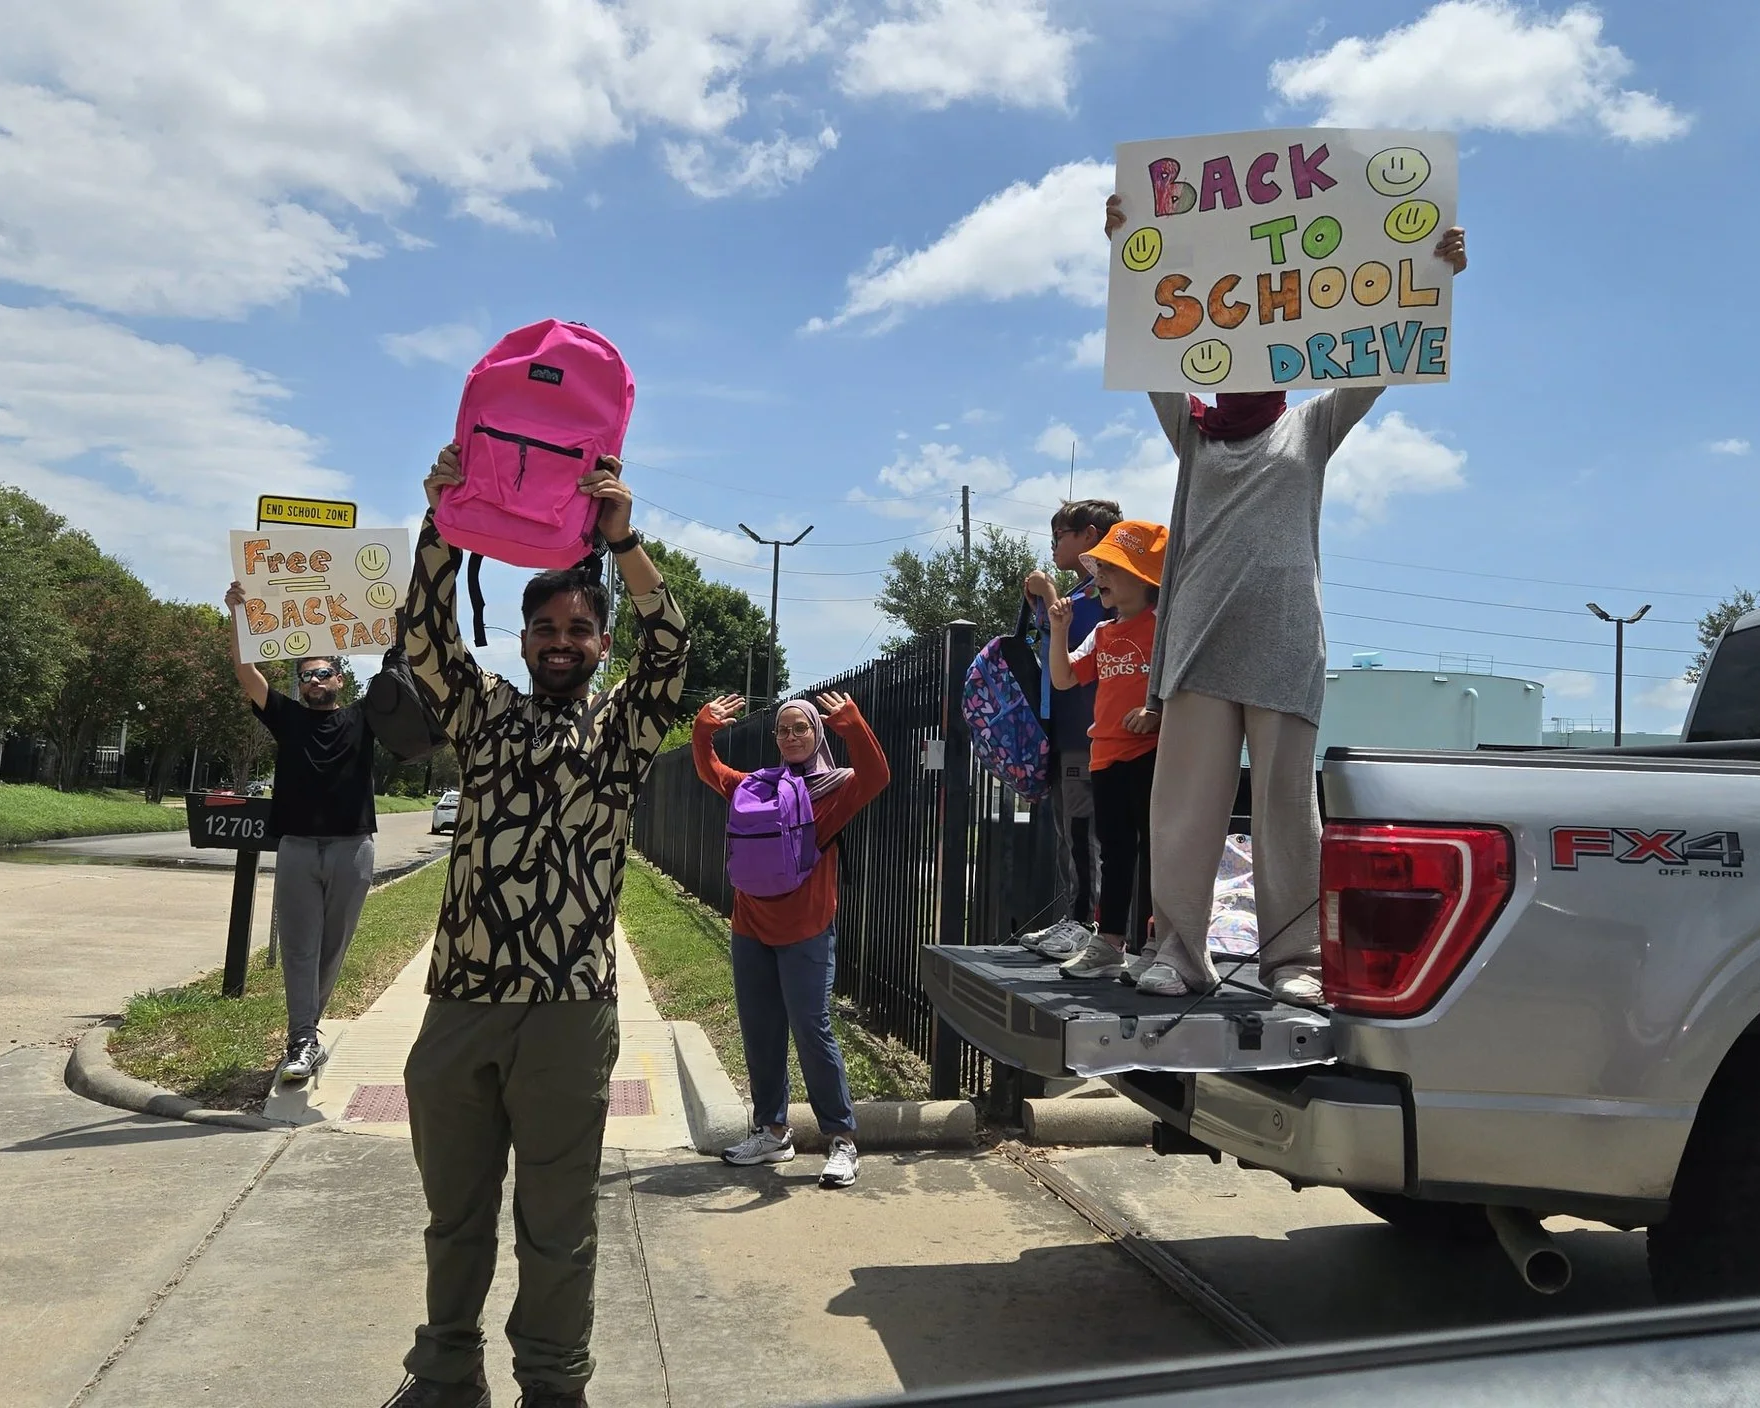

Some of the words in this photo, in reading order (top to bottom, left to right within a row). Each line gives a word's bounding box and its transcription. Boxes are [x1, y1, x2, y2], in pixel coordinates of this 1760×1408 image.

[1148, 143, 1338, 217] BACK
[1250, 215, 1342, 265] TO
[1152, 259, 1440, 339] SCHOOL
[1267, 321, 1447, 383] DRIVE
[266, 503, 284, 516] END
[287, 505, 322, 519] SCHOOL
[325, 508, 349, 522] ZONE
[244, 539, 332, 574] Free
[245, 593, 358, 635] BACK
[205, 814, 265, 839] 12703
[1549, 825, 1744, 871] FX4
[1658, 868, 1692, 877] OFF
[1699, 869, 1744, 878] ROAD
